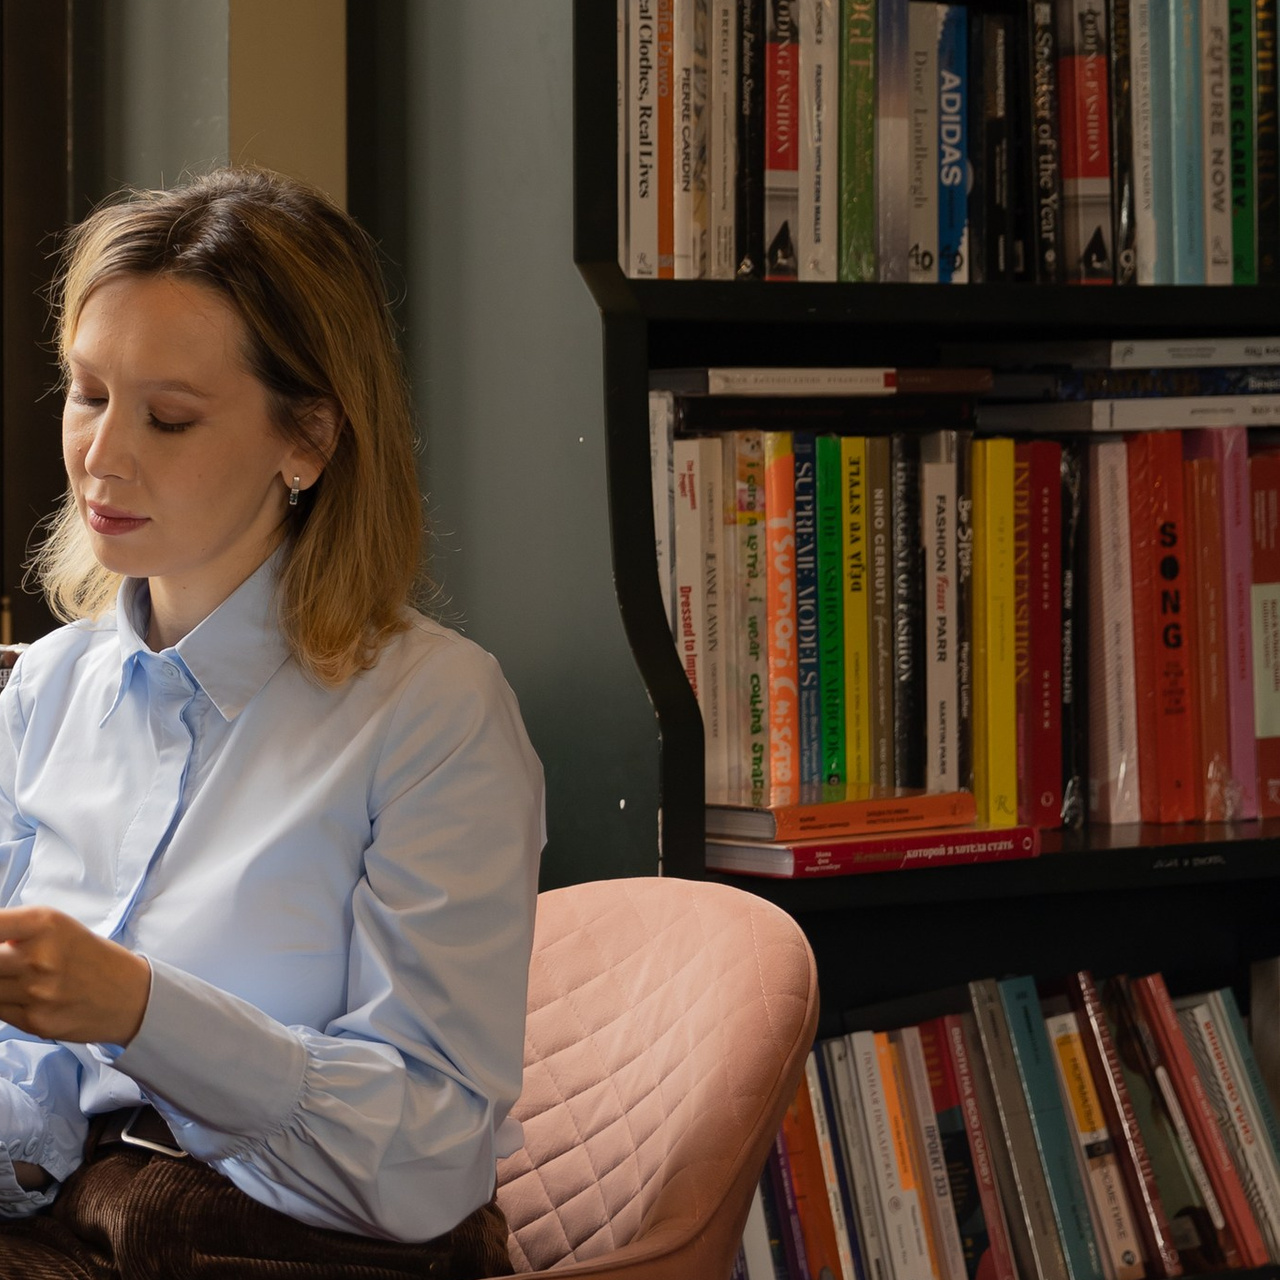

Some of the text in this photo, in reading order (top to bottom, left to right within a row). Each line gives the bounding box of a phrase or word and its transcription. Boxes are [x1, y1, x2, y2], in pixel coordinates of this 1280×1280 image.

[721, 8, 729, 77] BREGUET
[1230, 7, 1244, 35] LA
[634, 24, 653, 103] Clothes,
[657, 40, 671, 98] Dawo
[995, 29, 1006, 119] FASHIONPEDIA
[1230, 42, 1244, 80] VIE
[637, 106, 653, 147] Real
[681, 67, 692, 193] PIERRE CARDIN
[939, 69, 962, 187] ADIDAS
[1036, 122, 1055, 148] of
[1209, 26, 1225, 213] FUTURE NOW
[1231, 85, 1244, 115] DE
[637, 151, 653, 199] Lives
[1038, 152, 1056, 192] the
[1231, 120, 1245, 191] CLARE
[1039, 193, 1059, 243] Year
[848, 456, 865, 592] DÉJÀ VU STYLE
[873, 488, 886, 605] NINO CERRUTI
[936, 495, 947, 572] FASHION
[706, 552, 718, 651] JEANNE LANVIN
[795, 461, 818, 686] SUPREME MODELS
[679, 585, 700, 702] Dressed to Impre
[821, 505, 840, 760] THE FASHION YEARBOOK
[895, 602, 912, 682] FASHION
[936, 616, 948, 663] PARR
[1014, 572, 1030, 684] FASHION
[938, 700, 947, 744] MARTIN
[907, 844, 946, 860] которой
[960, 1073, 975, 1097] НА
[1203, 1020, 1235, 1103] ОБОНЯНИЯ
[964, 1096, 982, 1129] ВСЮ
[1234, 1105, 1255, 1147] СИЛА
[924, 1123, 949, 1198] ПРОЕКТ 333
[970, 1129, 994, 1186] ГОЛОВУ
